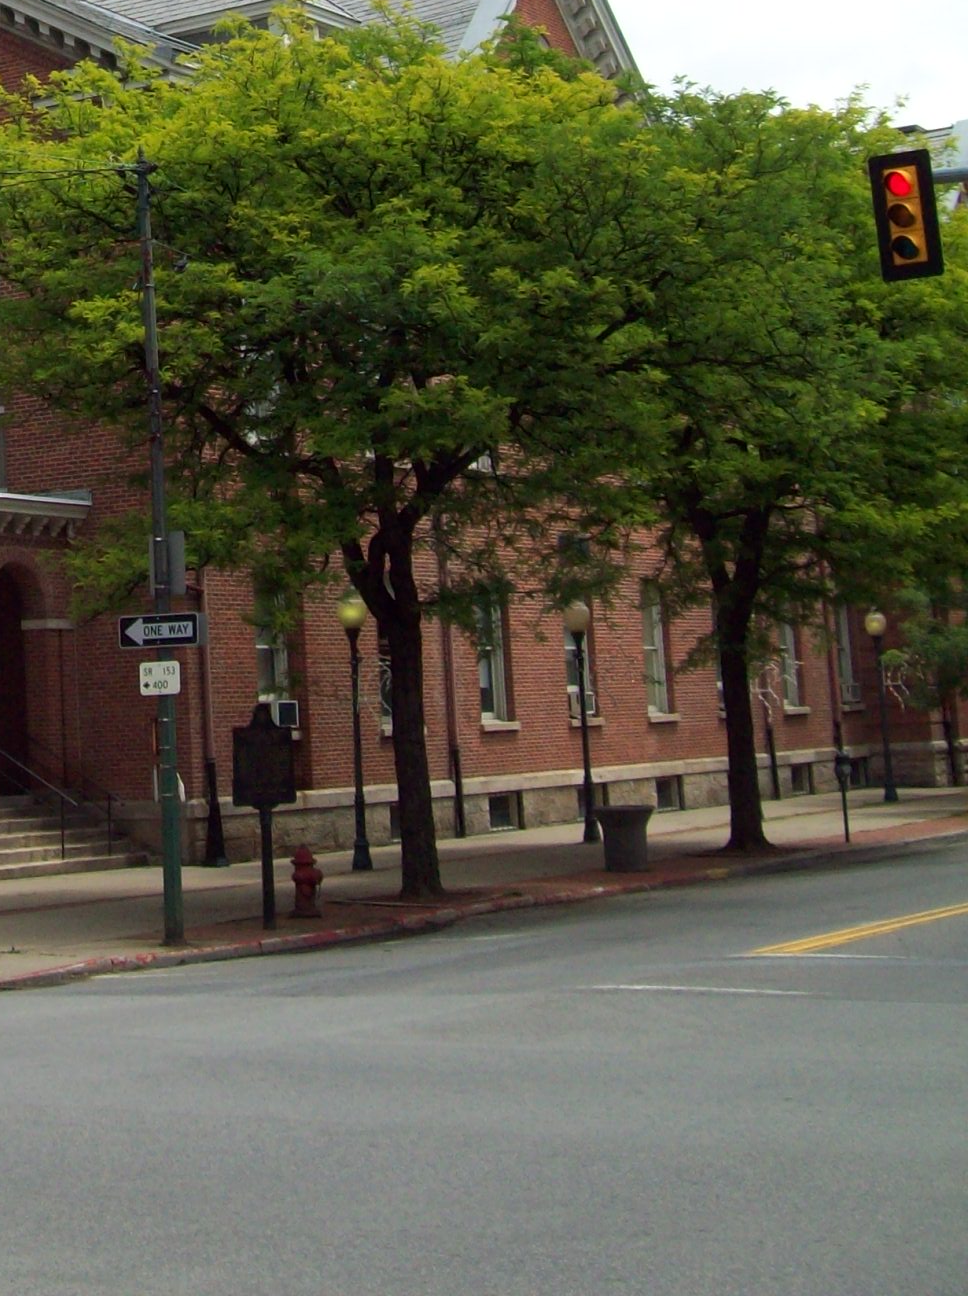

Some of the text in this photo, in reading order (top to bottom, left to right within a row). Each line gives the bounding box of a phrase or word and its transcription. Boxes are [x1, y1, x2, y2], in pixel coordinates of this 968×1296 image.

[143, 624, 189, 636] ONE WAY
[143, 666, 176, 677] SR 153
[152, 680, 169, 690] 400
